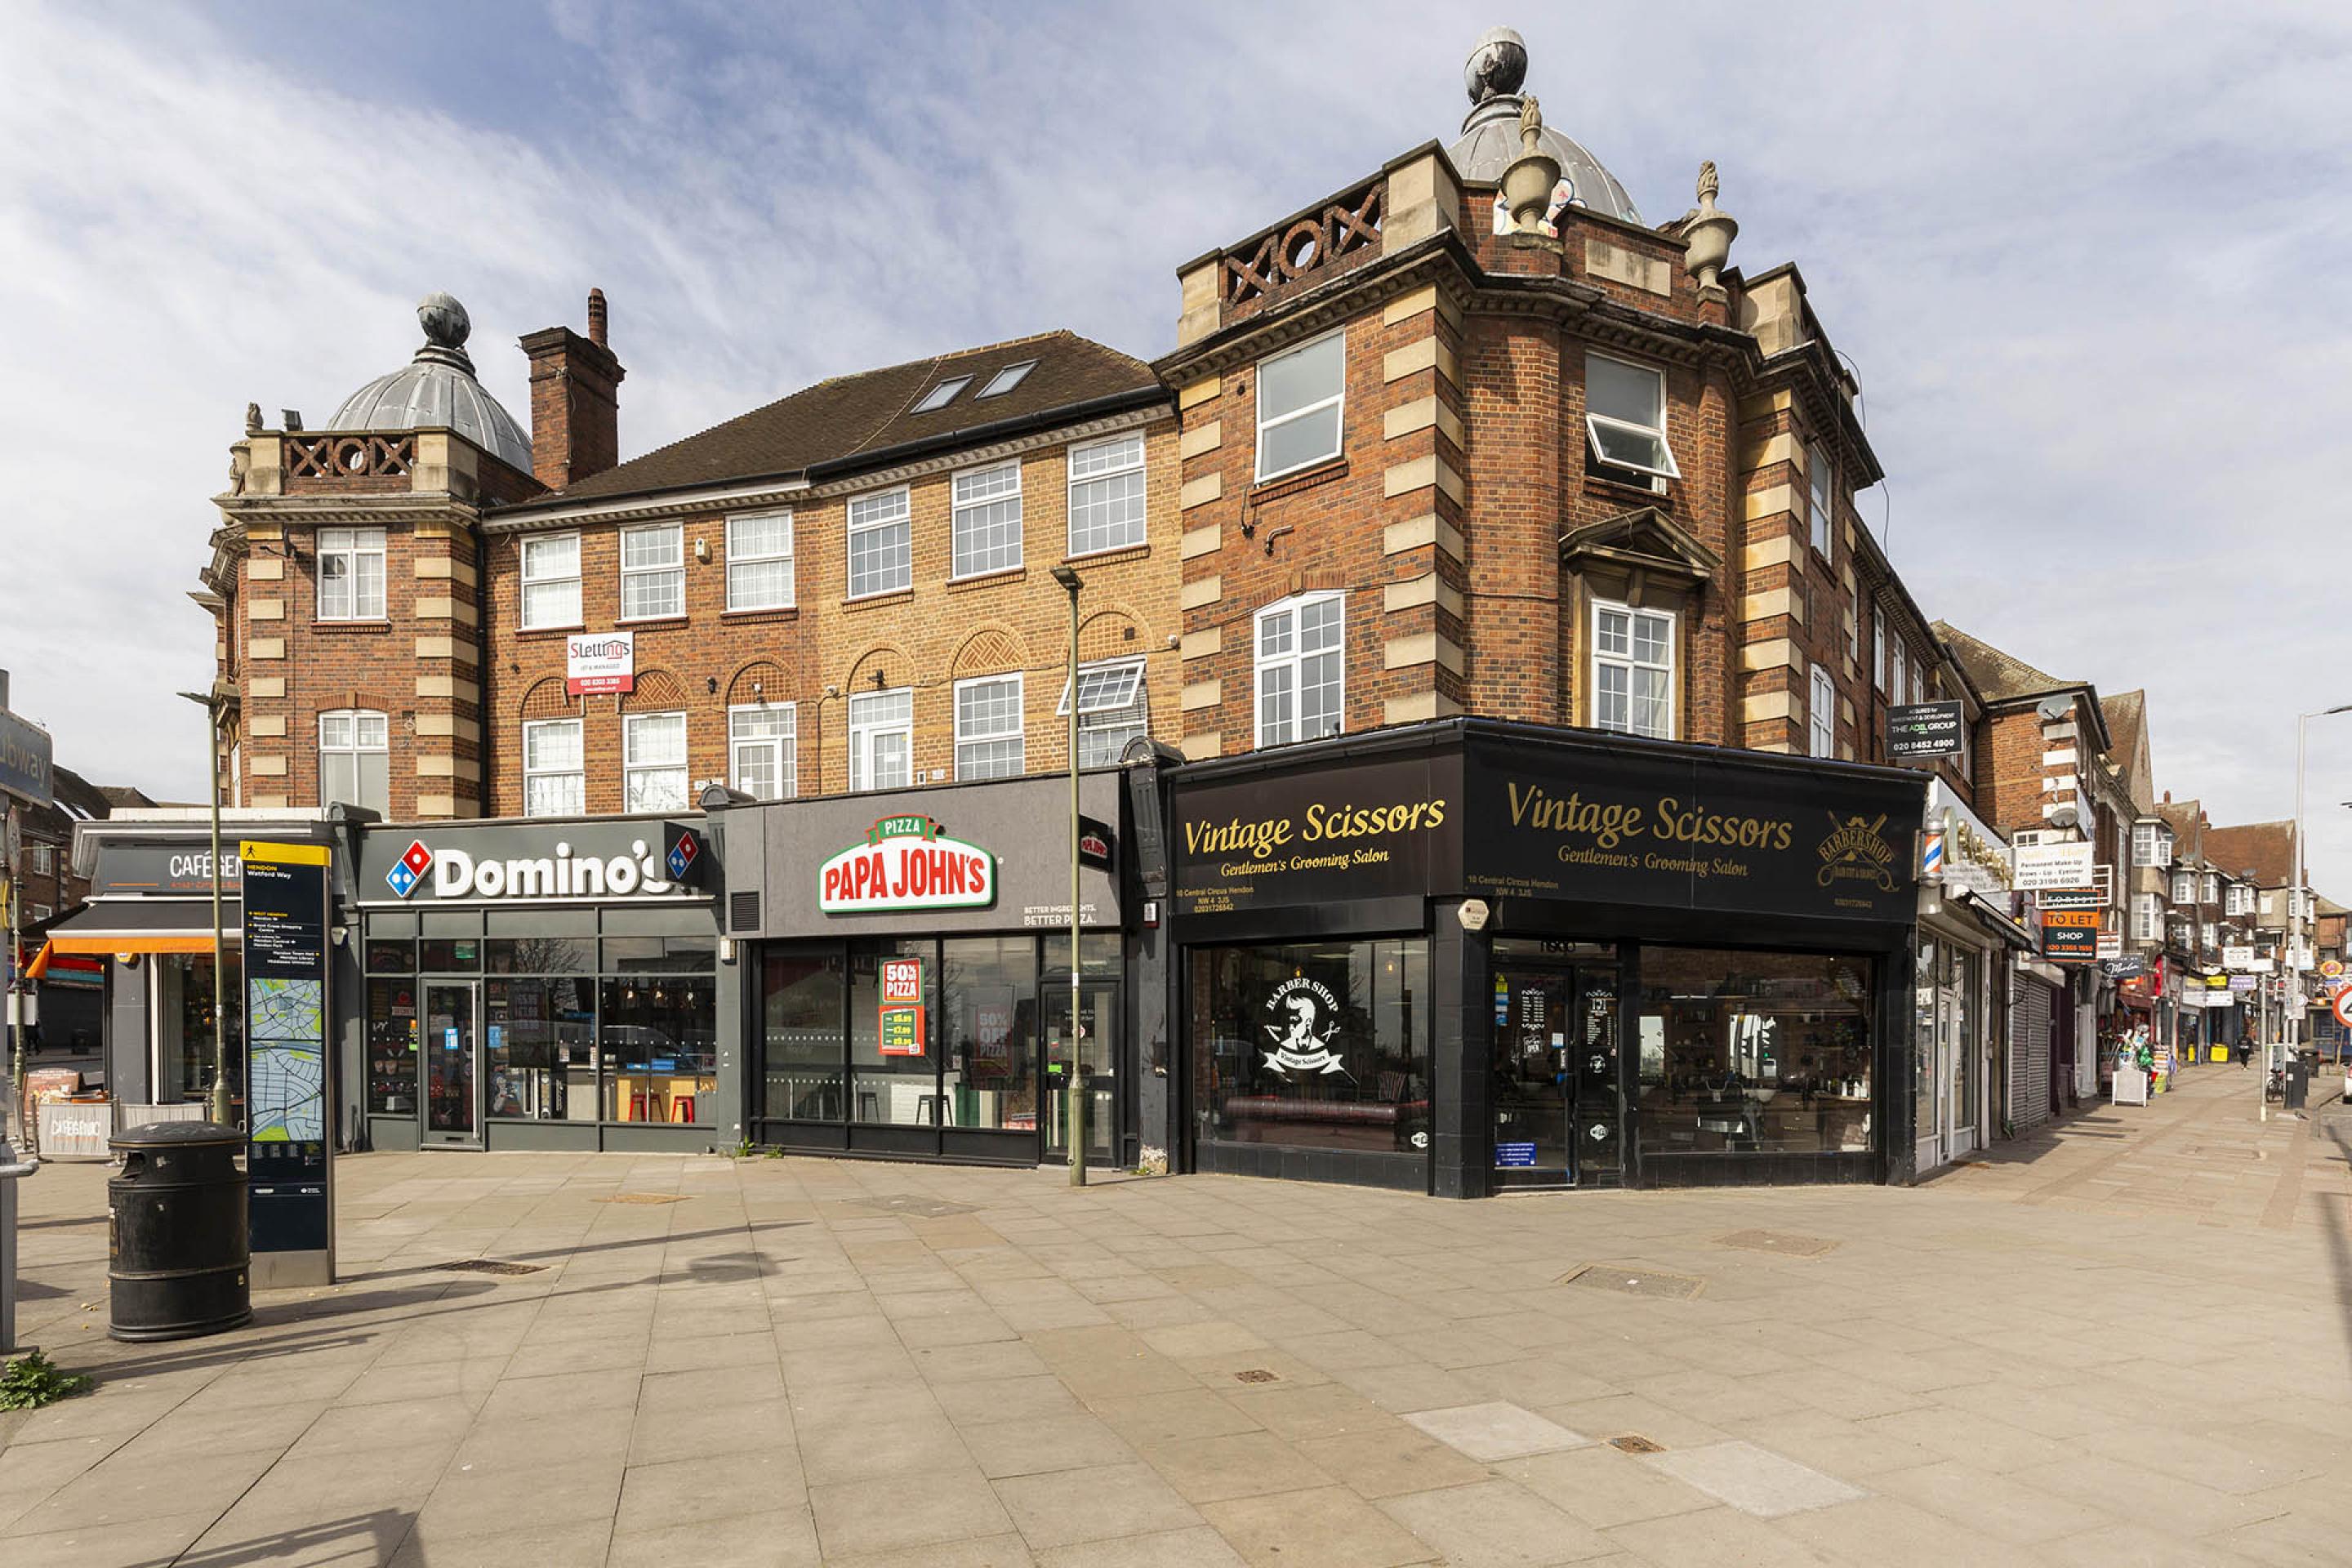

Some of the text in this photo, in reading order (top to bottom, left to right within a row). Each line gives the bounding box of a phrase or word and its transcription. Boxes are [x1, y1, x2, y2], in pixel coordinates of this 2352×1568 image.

[1891, 724, 1909, 733] THE
[1928, 720, 1958, 731] GROUP
[1893, 742, 1909, 751] 020
[1932, 737, 1955, 748] 4900
[1508, 782, 1793, 850] Vintage Scissors
[884, 818, 920, 835] PIZZA
[1185, 799, 1446, 858] Vintage Scissors
[1818, 830, 1893, 863] BARBERSHOP
[247, 864, 278, 872] HENDON
[1220, 848, 1390, 877] Gentlemen's Grooming Salon
[1558, 844, 1749, 878] Gentlemen's Grooming Salon
[247, 870, 292, 880] Watford Way
[434, 840, 674, 898] Domino's
[825, 848, 986, 902] PAPA JOHN'S
[2022, 879, 2038, 887] 020
[1184, 889, 1206, 897] Central
[1229, 886, 1254, 894] Hendon
[1197, 897, 1209, 905] NW
[1024, 906, 1049, 914] BETTER
[1023, 913, 1097, 926] BETTER PIZA.
[2047, 915, 2093, 925] TO LET
[2056, 931, 2083, 940] SHOP
[887, 982, 917, 997] PIZZA
[1266, 977, 1339, 1012] BARBER SHOP
